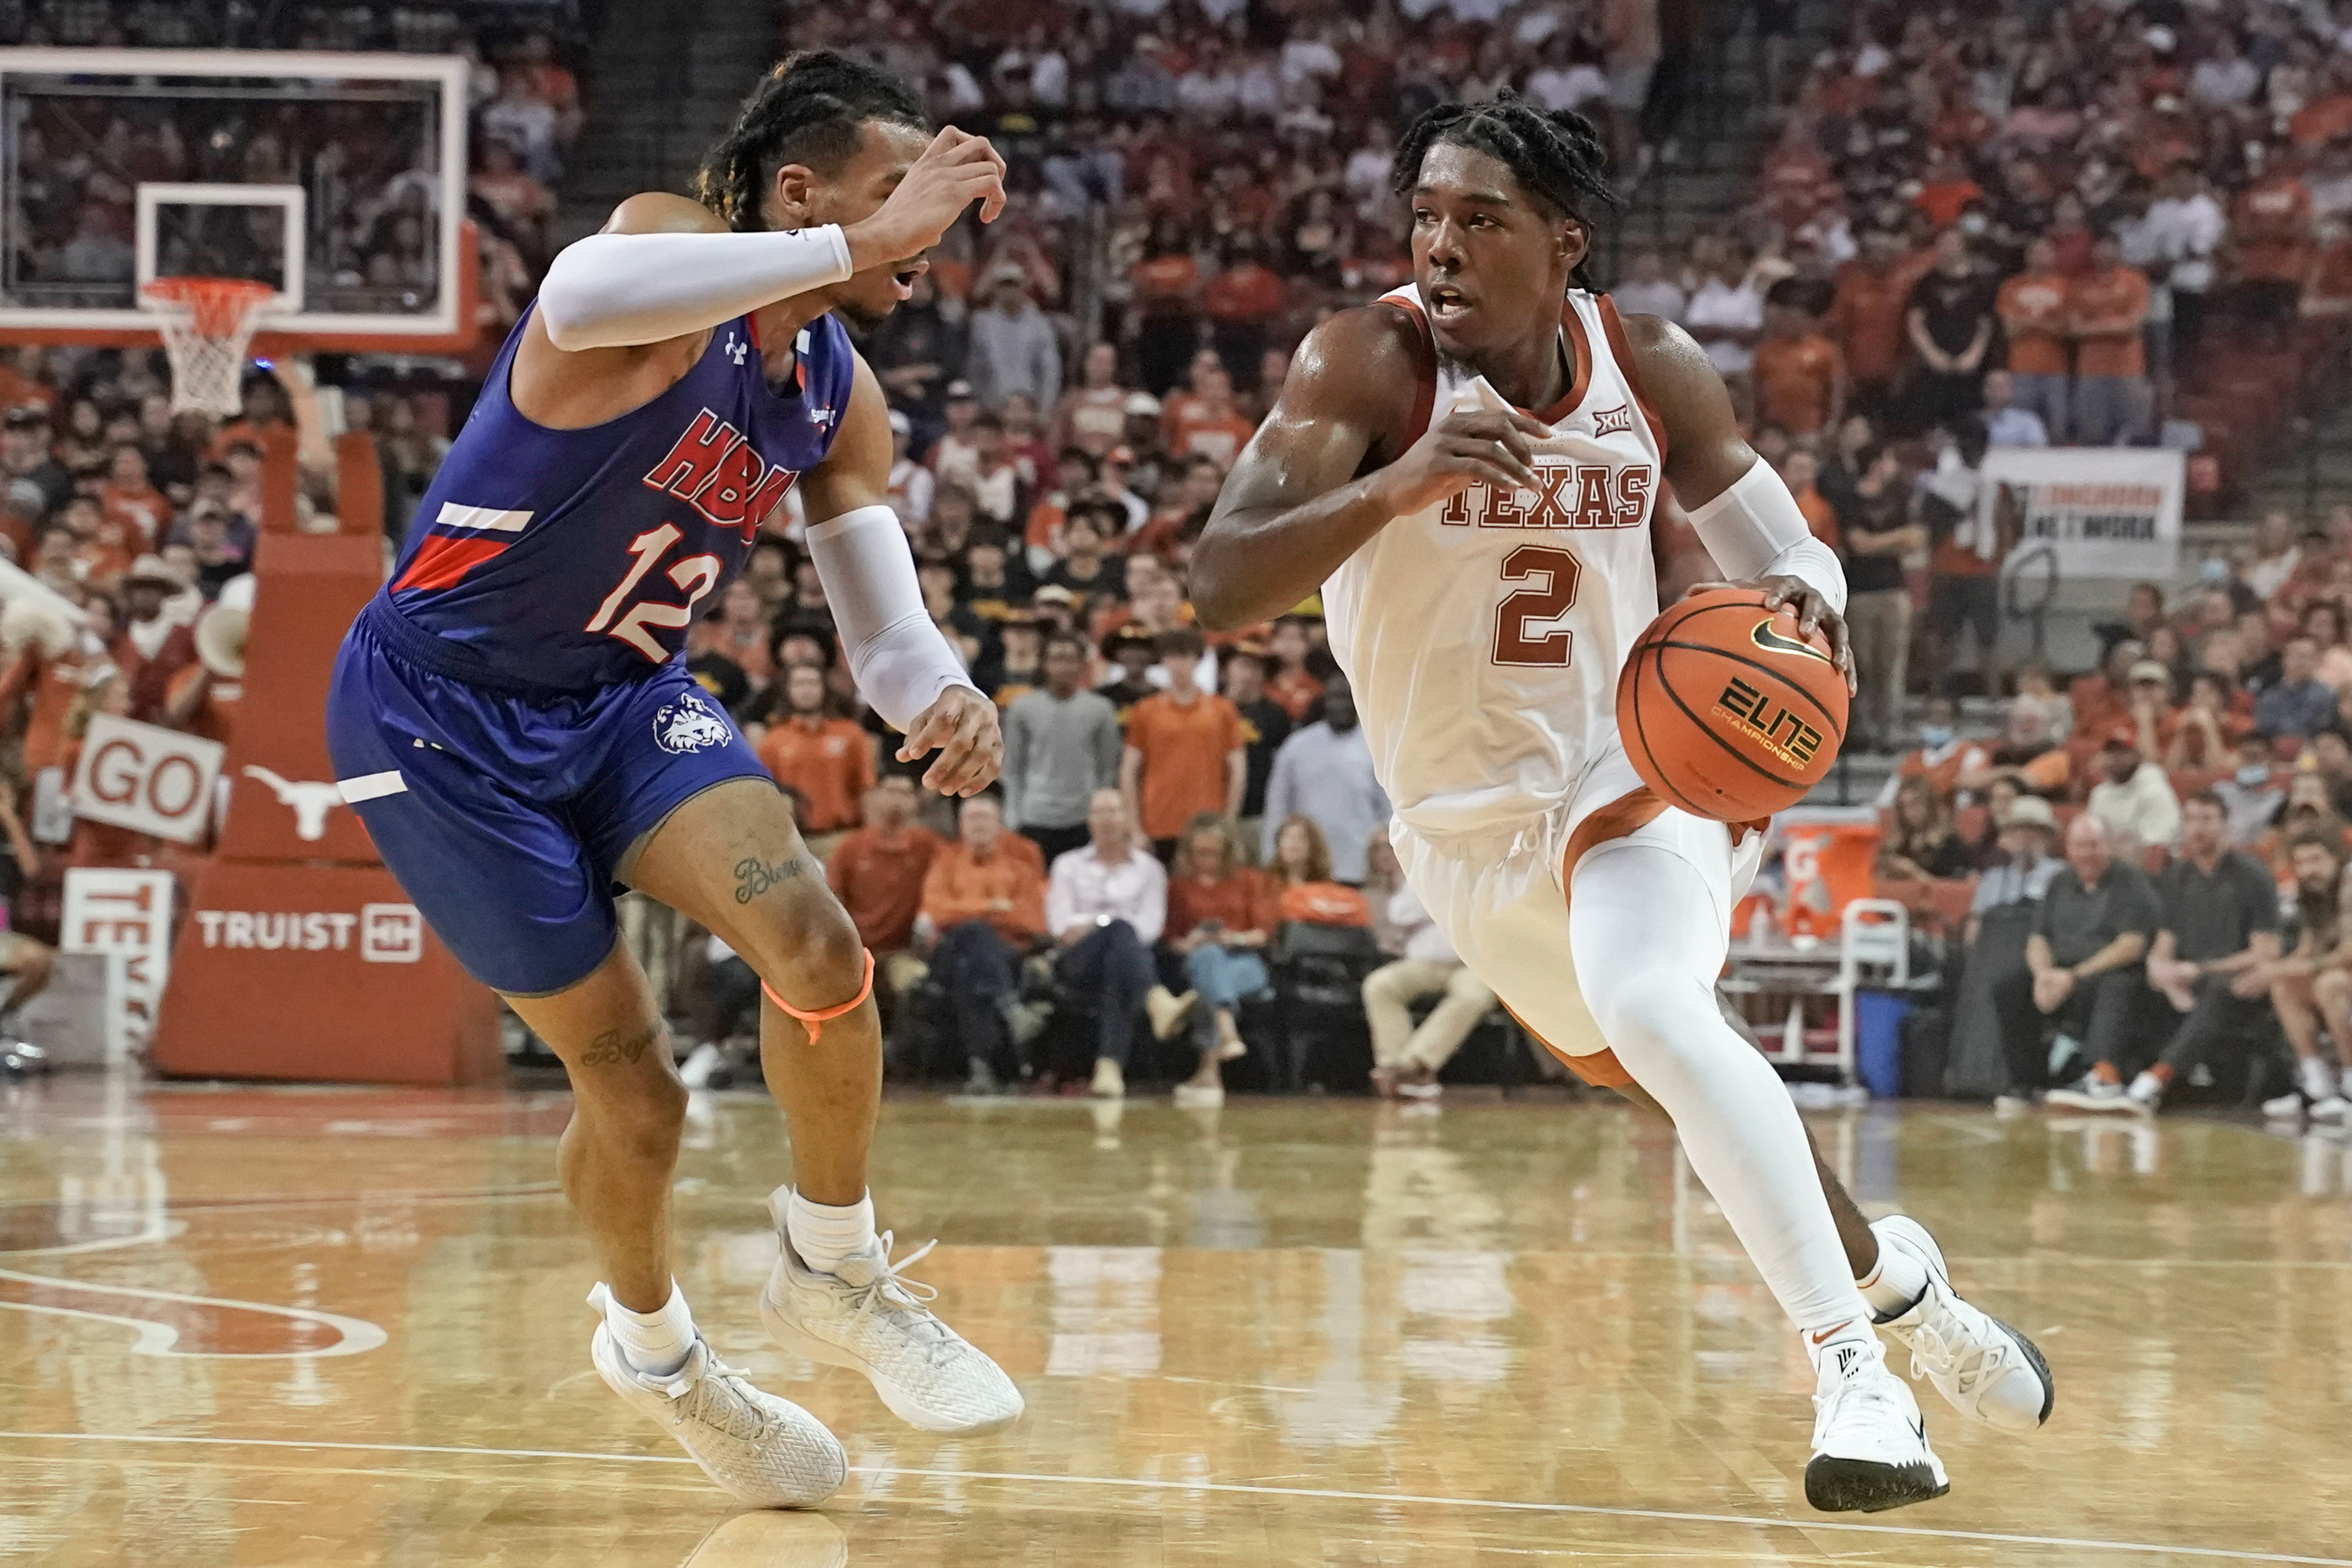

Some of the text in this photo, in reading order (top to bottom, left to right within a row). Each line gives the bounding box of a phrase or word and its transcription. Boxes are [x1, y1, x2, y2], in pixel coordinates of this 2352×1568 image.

[1442, 464, 1652, 529] TEXAS
[585, 521, 722, 664] 12
[1491, 544, 1582, 667] 2
[1710, 706, 1805, 772] CHAMPIONSHIP
[1718, 676, 1824, 764] ELITE
[90, 739, 200, 817] GO
[197, 909, 356, 950] TRUIST
